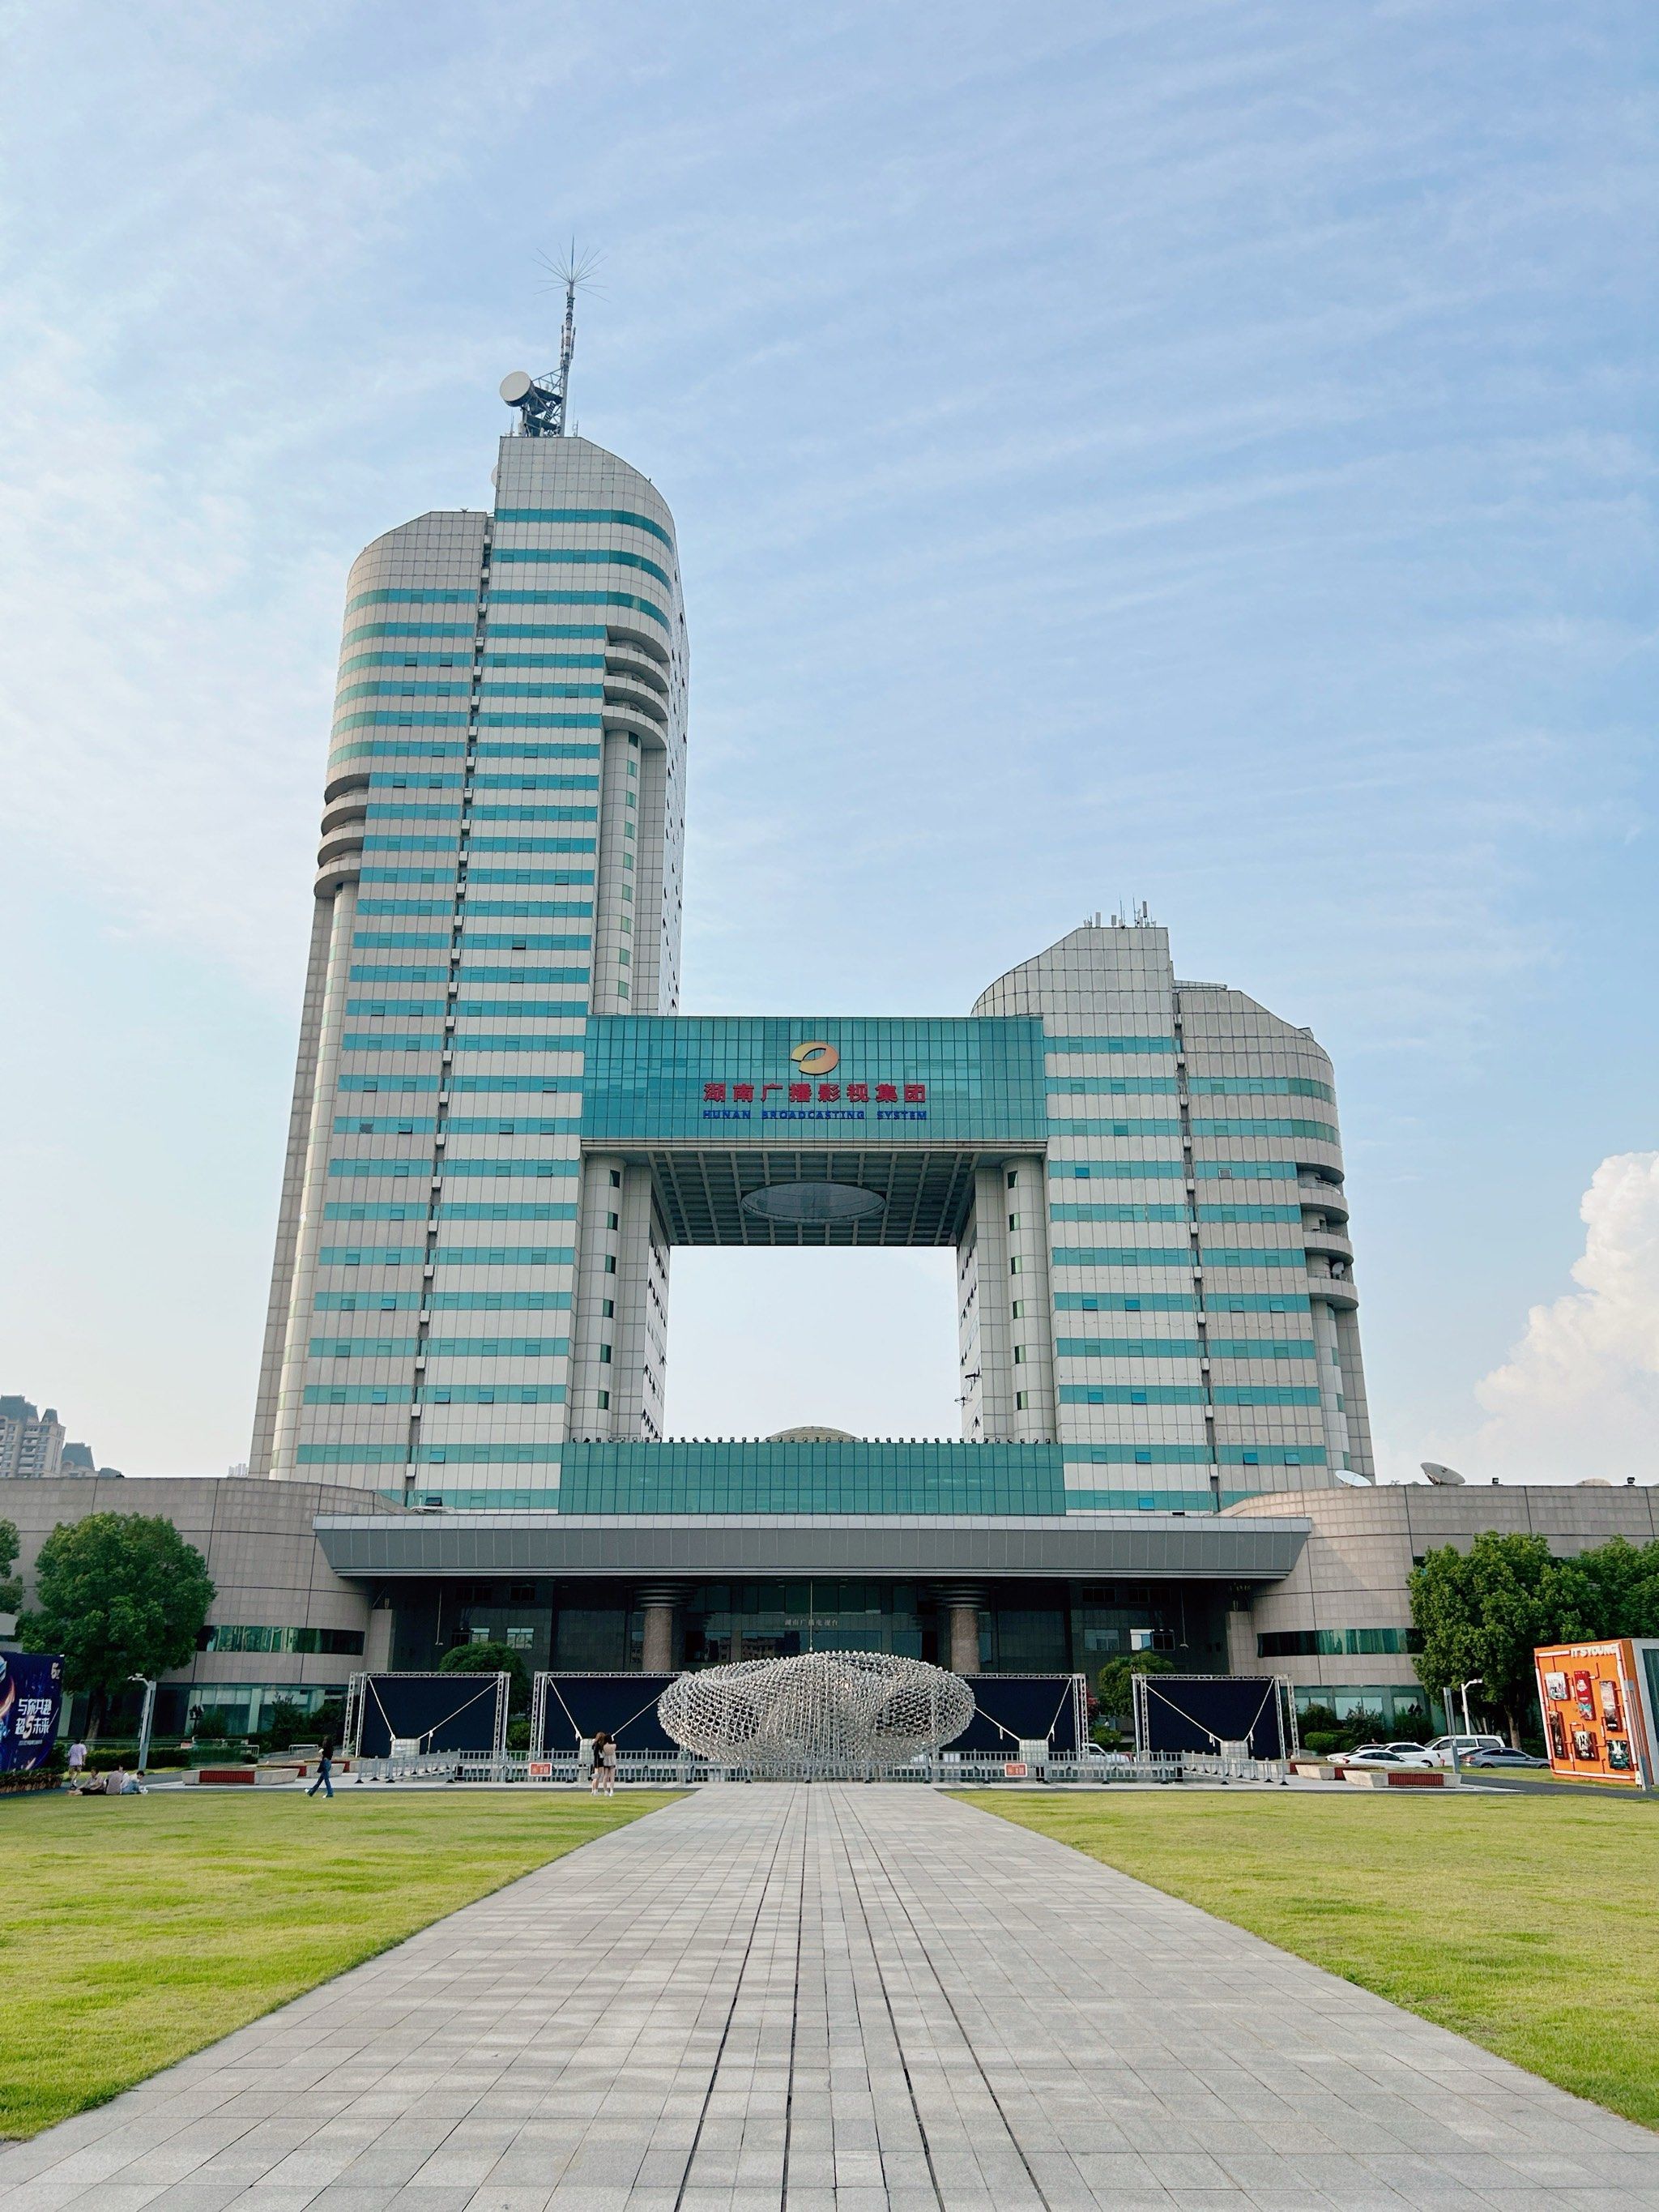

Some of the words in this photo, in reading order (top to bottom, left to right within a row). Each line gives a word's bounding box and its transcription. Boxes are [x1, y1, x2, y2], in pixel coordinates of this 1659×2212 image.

[704, 1083, 926, 1103] 湖南广播影视集团
[703, 1110, 751, 1119] HUNAN
[762, 1110, 865, 1119] BROADCASTING
[877, 1111, 927, 1120] SYSTEM
